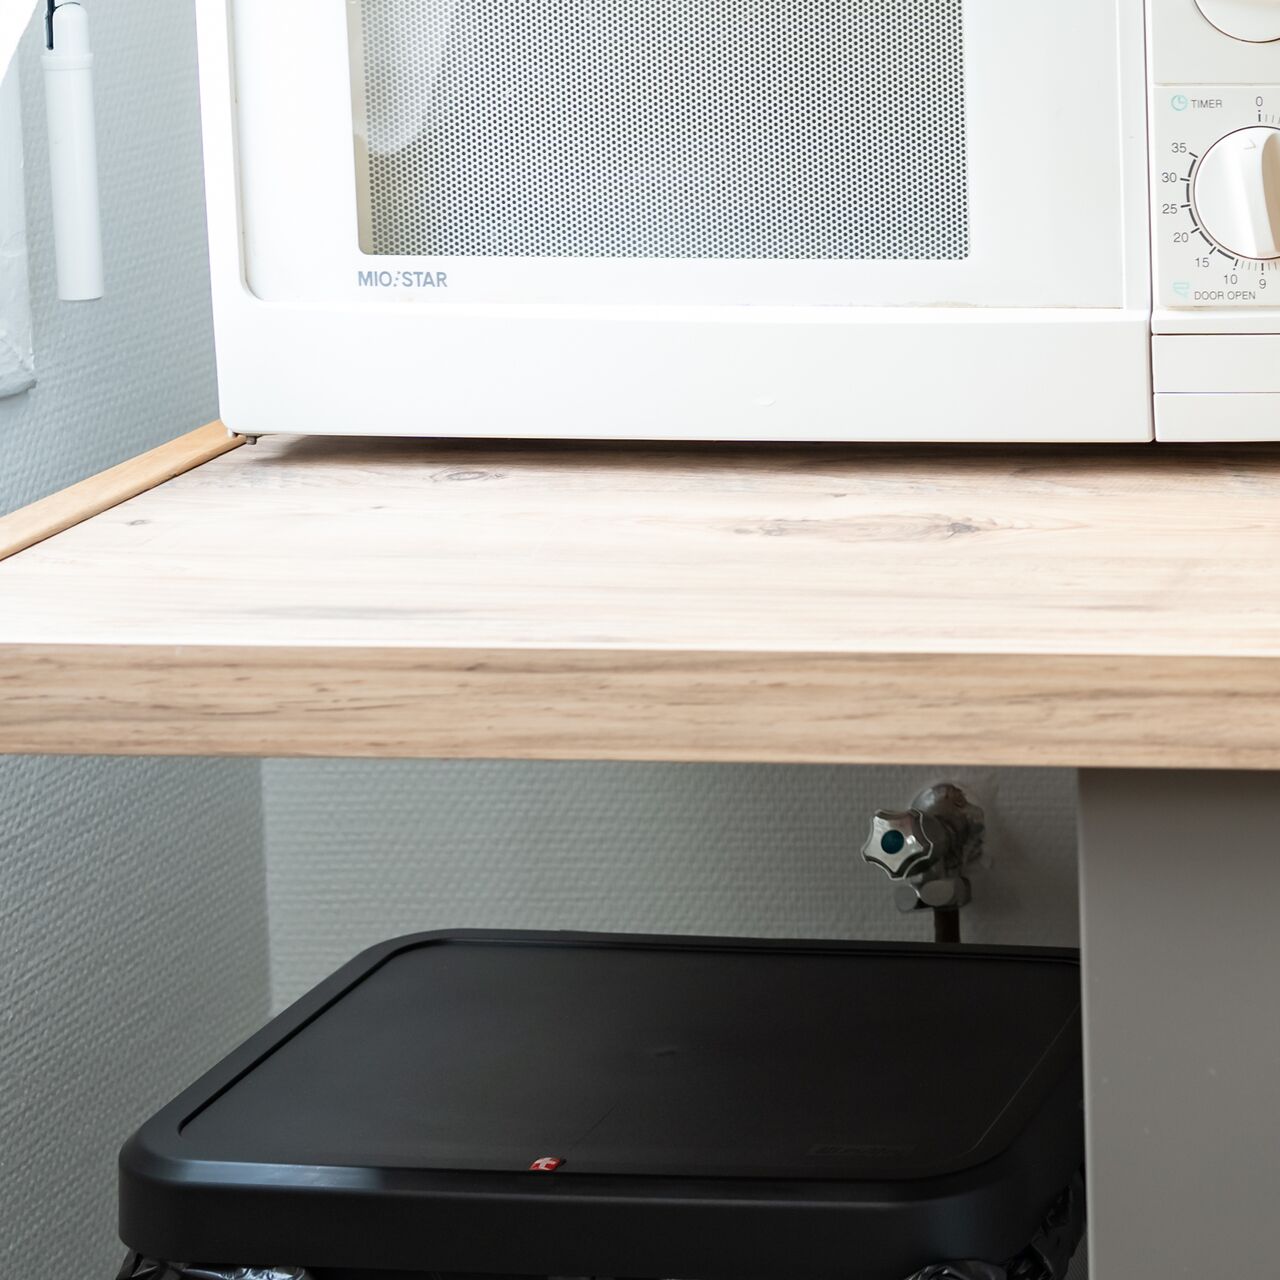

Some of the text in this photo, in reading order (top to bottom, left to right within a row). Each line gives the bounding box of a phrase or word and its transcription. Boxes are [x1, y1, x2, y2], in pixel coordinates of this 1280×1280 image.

[1190, 99, 1223, 109] TIMER
[1255, 96, 1264, 107] 0
[1171, 142, 1187, 153] 35
[1161, 172, 1177, 183] 30
[1162, 203, 1178, 215] 25
[1173, 232, 1189, 243] 20
[1195, 257, 1210, 268] 15
[1223, 274, 1238, 285] 10
[1258, 279, 1267, 290] 9
[1194, 291, 1256, 301] DOOR OPEN
